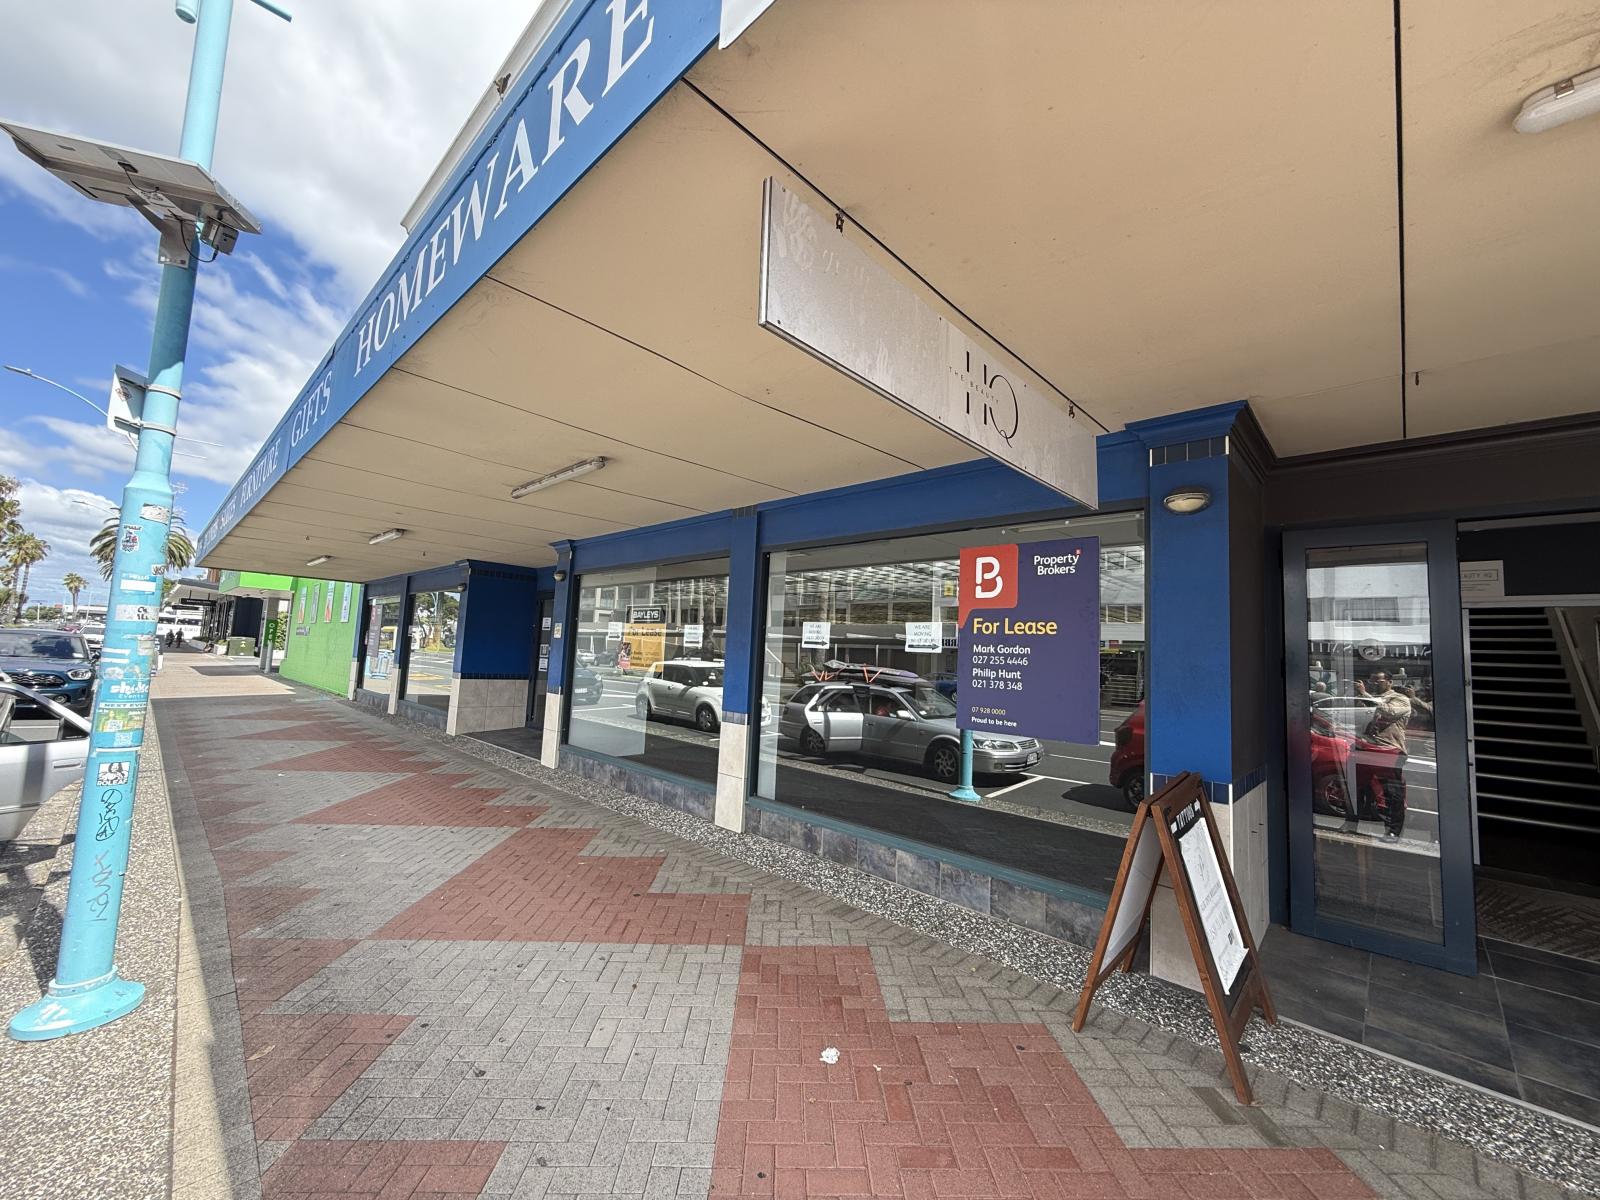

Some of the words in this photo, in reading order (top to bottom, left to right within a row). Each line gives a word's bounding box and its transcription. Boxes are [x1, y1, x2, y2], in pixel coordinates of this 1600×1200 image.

[291, 371, 332, 447] GIFTS
[353, 0, 655, 377] HOMEWARE
[949, 366, 965, 382] THE
[970, 380, 999, 404] BEAUTY
[966, 350, 1019, 449] HQ
[1034, 553, 1080, 567] Property
[1037, 564, 1076, 576] Brokers
[975, 556, 1003, 599] B
[633, 610, 659, 619] BAYLEYS
[973, 617, 1000, 635] For
[1004, 617, 1058, 635] Lease
[973, 644, 996, 653] Mark
[997, 644, 1031, 655] Gordon
[972, 655, 988, 664] 027
[990, 656, 1005, 665] 255
[1006, 657, 1029, 666] 4446
[972, 667, 997, 680] Philip
[998, 669, 1022, 679] Hunt
[972, 679, 987, 688] 021
[989, 680, 1005, 690] 378
[1006, 681, 1023, 691] 348
[991, 708, 1006, 716] 0000
[971, 716, 988, 724] Proud
[1176, 803, 1195, 829] TATTOOS
